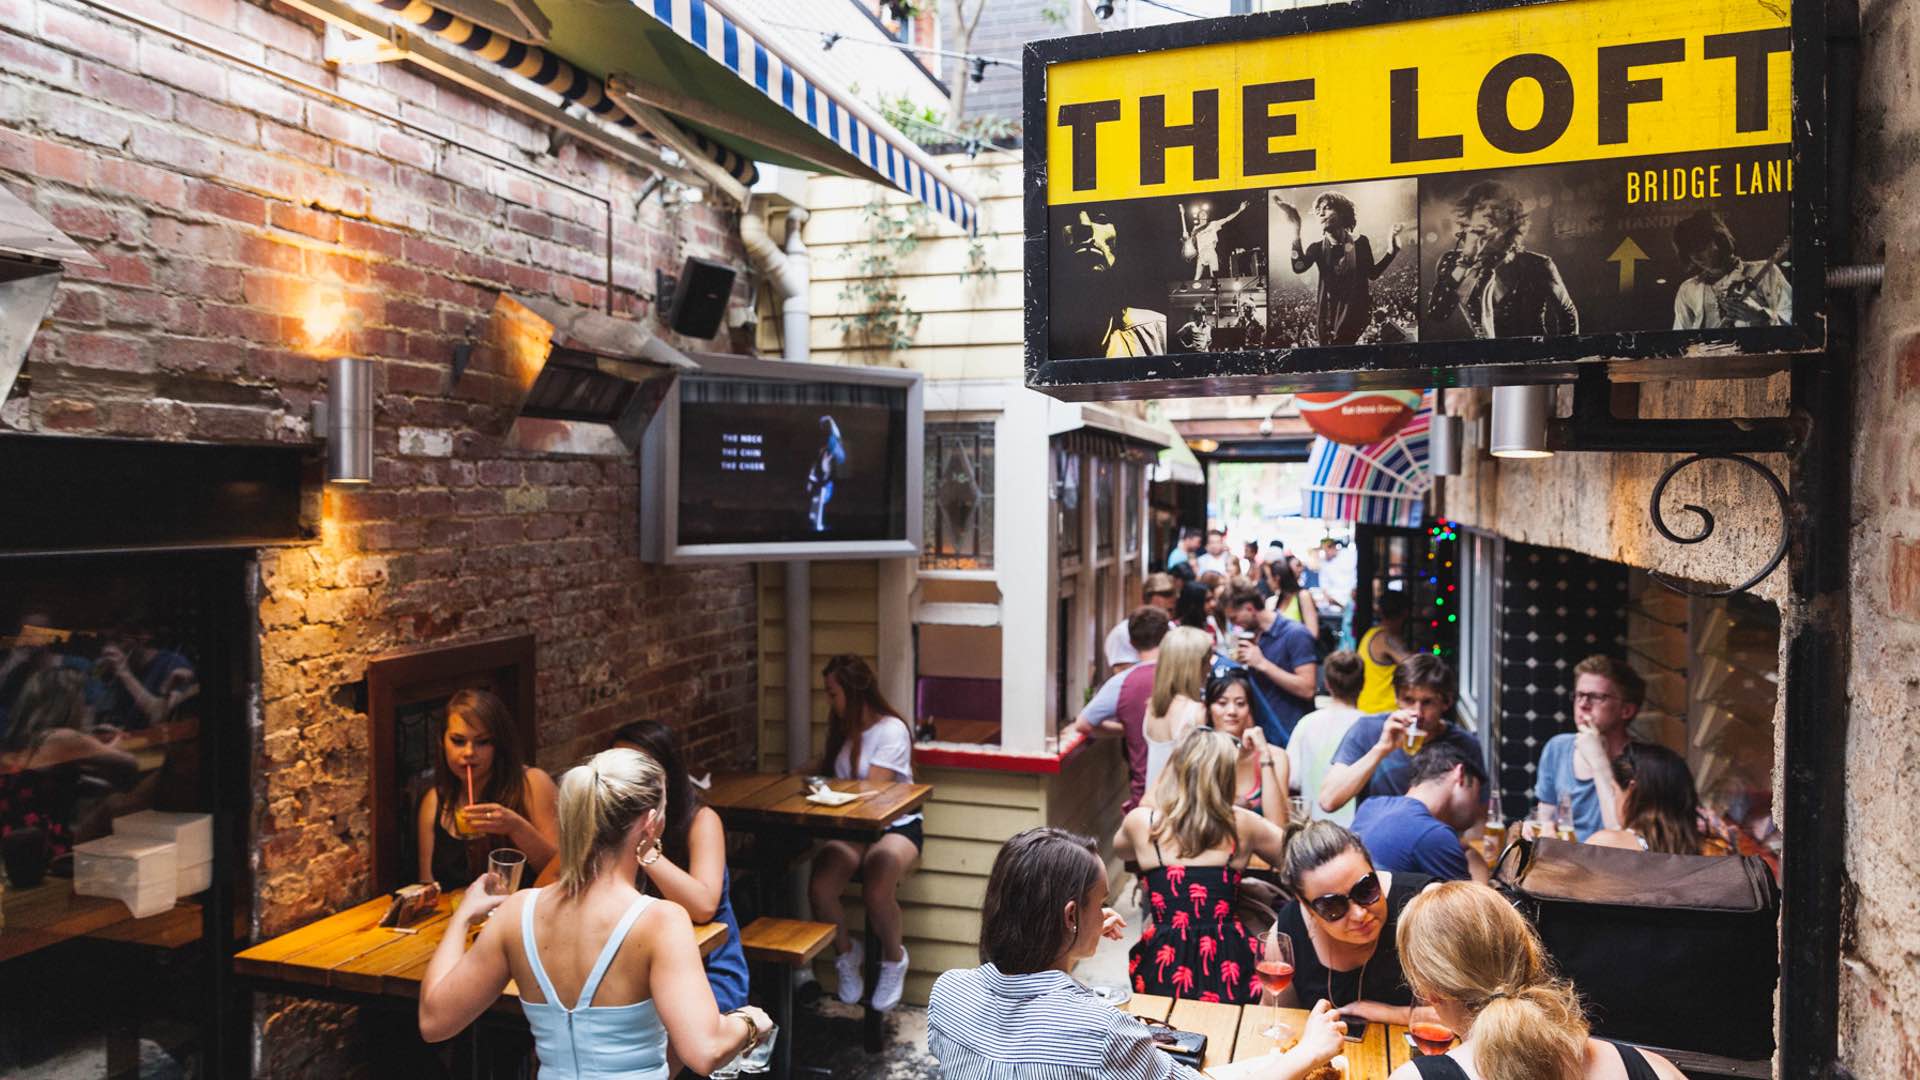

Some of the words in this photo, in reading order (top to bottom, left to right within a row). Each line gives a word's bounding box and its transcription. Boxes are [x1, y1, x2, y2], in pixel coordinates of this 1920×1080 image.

[1057, 78, 1316, 191] THE
[1390, 27, 1791, 164] LOFT
[1627, 165, 1722, 204] BRIDGE
[723, 434, 738, 443] THE
[722, 448, 737, 457] THE
[721, 461, 737, 471] THE
